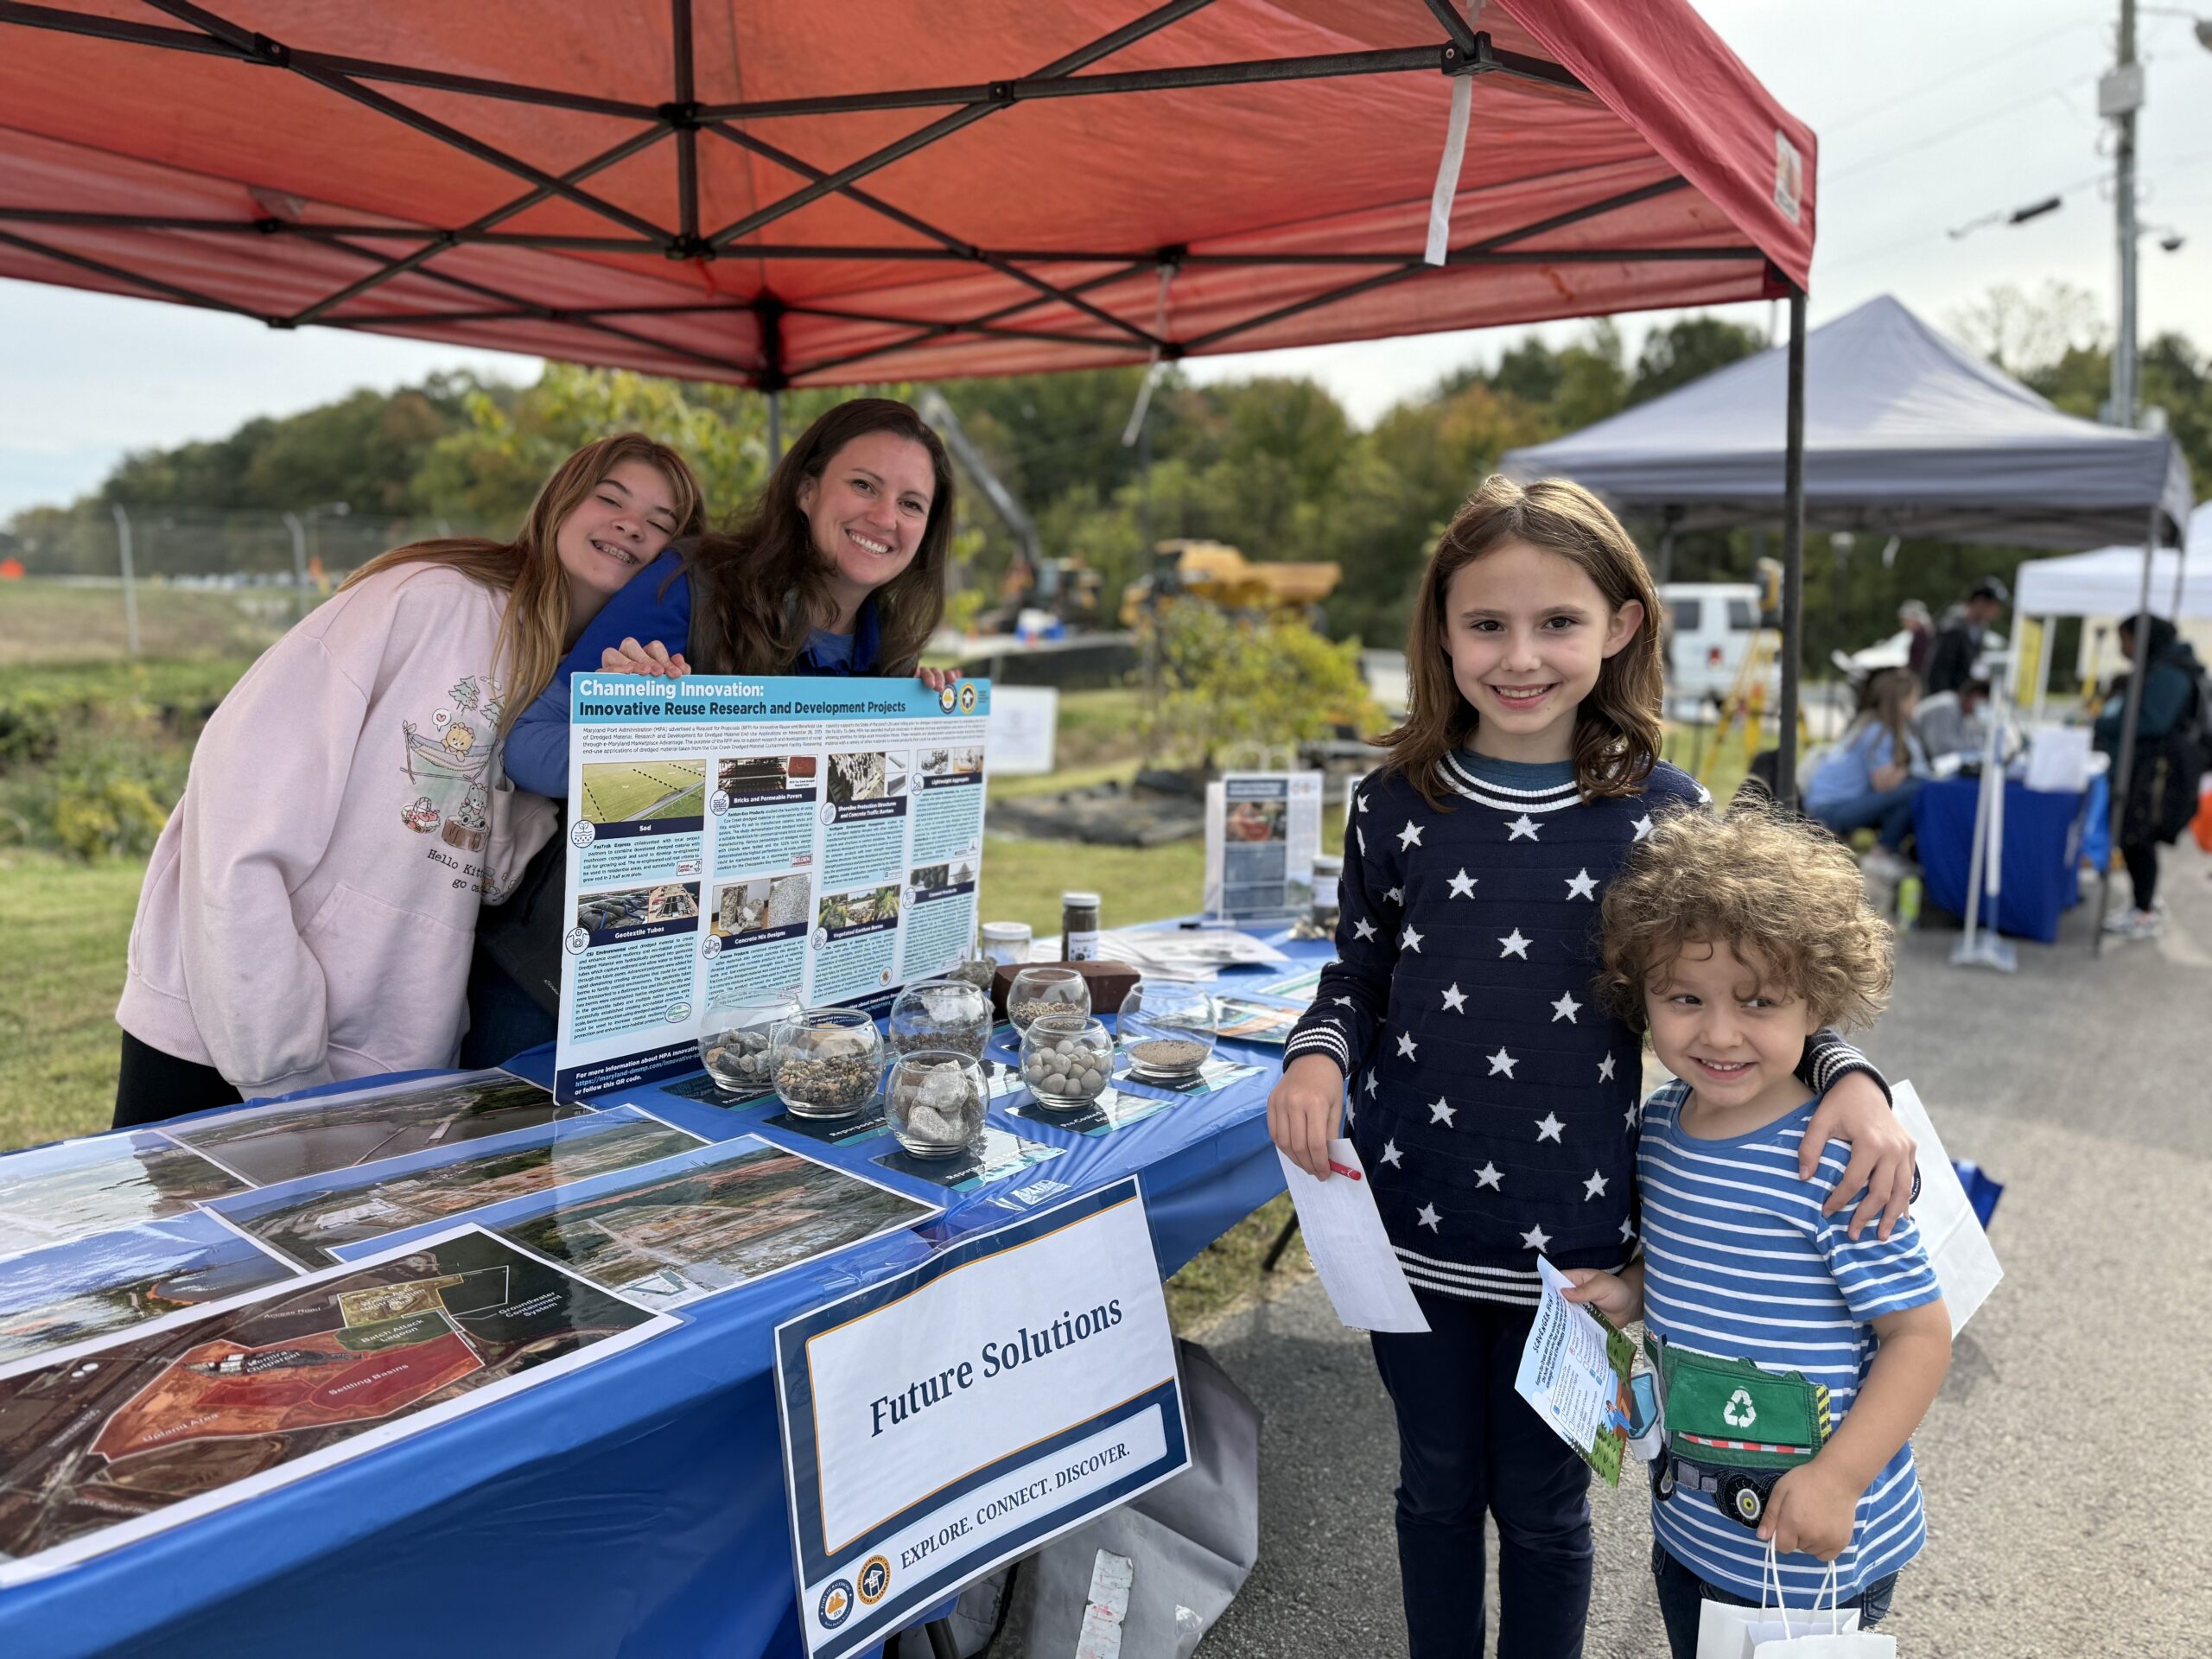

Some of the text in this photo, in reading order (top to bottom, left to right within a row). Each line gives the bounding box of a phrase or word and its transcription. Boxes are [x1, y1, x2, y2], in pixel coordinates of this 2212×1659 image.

[580, 679, 764, 699] Channeling Innovation:
[580, 701, 906, 715] Innovative Reuse Research and Development Projects
[428, 849, 485, 878] Hello Kitt
[452, 879, 467, 888] go
[615, 930, 645, 938] Geotextile
[833, 930, 855, 938] Vegetated
[605, 1060, 640, 1072] information
[583, 1084, 602, 1093] follow
[829, 1122, 874, 1137] Repurpose
[498, 1290, 556, 1315] Groundwater
[505, 1294, 563, 1318] Containment
[523, 1302, 557, 1318] System
[361, 1319, 424, 1344] Batch Attack
[379, 1326, 419, 1344] Lagoon
[1533, 1312, 1550, 1353] SCAVENGER
[246, 1351, 301, 1374] Outparcel
[247, 1350, 289, 1367] Kemira
[870, 1299, 1123, 1438] Future Solutions
[328, 1363, 409, 1395] Settling Basins
[142, 1413, 219, 1442] Upland Area
[900, 1442, 1131, 1570] EXPLORE. CONNECT. DISCOVER.
